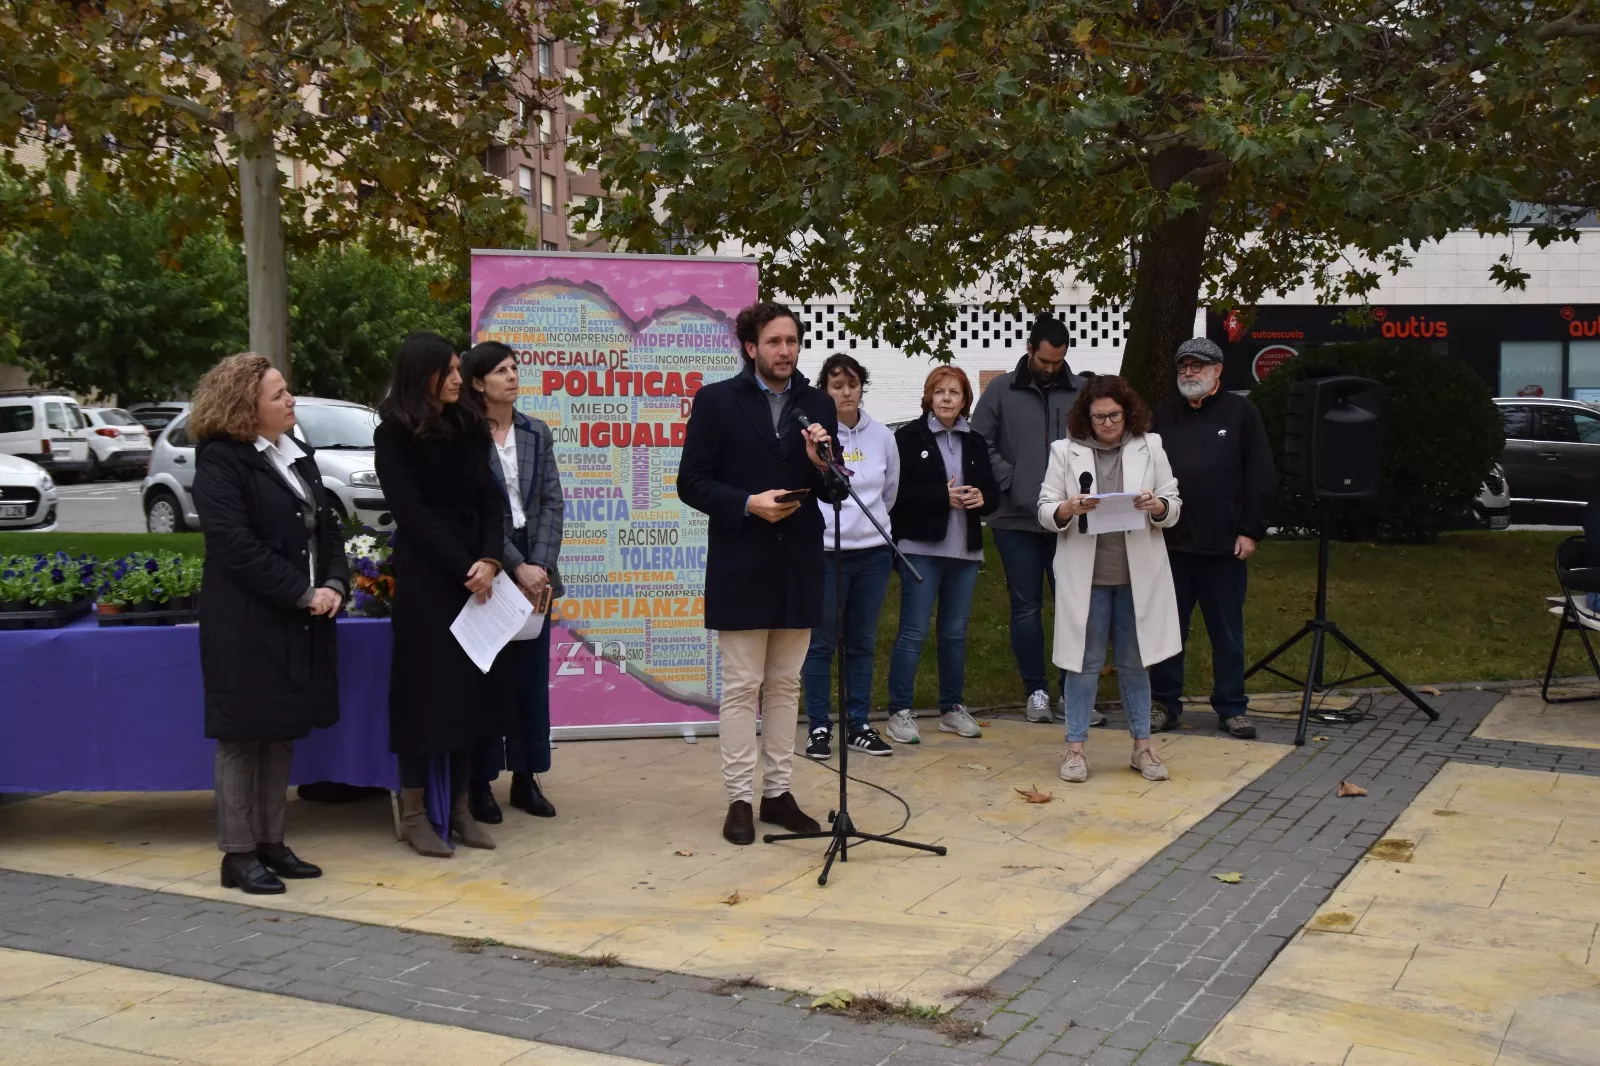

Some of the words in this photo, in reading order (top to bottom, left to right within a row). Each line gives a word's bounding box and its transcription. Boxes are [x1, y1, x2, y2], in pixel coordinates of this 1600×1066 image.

[502, 305, 550, 313] EDUCACIÓN
[526, 313, 579, 327] AYUDA
[477, 332, 547, 343] SISTEMA
[546, 333, 632, 342] INCOMPRENSIÓN
[1251, 330, 1304, 339] autoescuela
[513, 350, 608, 366] CONCEJALÍA
[609, 350, 629, 370] DE
[630, 355, 654, 363] LEYES
[655, 355, 738, 364] INCOMPRENSIÓN
[542, 370, 704, 397] POLÍTICAS
[571, 403, 628, 414] MIEDO
[650, 448, 662, 508] VIOLENCIA
[630, 511, 680, 520] VALENTÍA
[630, 520, 680, 529] CULTURA
[564, 529, 608, 539] EJUICIOS
[618, 529, 678, 545] RACISMO
[608, 571, 675, 582] SISTEMA
[634, 583, 684, 591] PREJUICIOS
[653, 643, 707, 651] POSITIVO
[652, 650, 701, 659] PASIVIDAD
[653, 658, 706, 667] VIGILANCIA
[653, 674, 707, 682] CONSENSO
